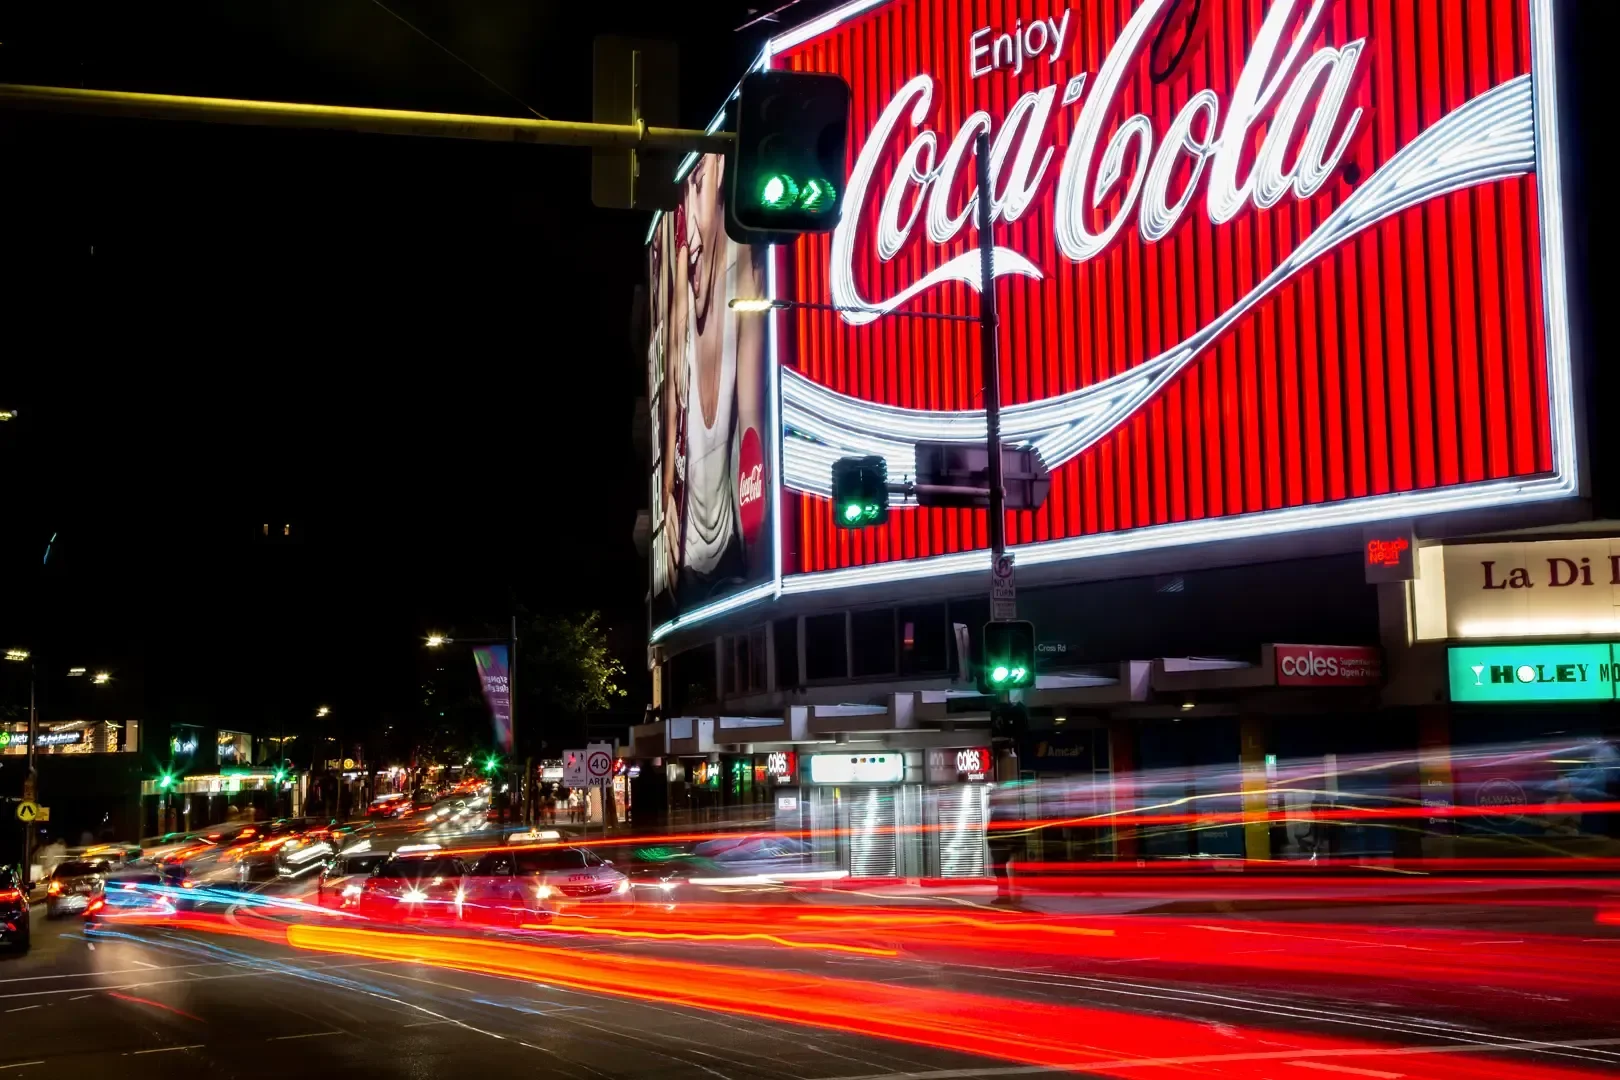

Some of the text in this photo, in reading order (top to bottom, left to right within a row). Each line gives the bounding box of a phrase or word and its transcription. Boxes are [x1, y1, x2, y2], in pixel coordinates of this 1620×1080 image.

[970, 8, 1070, 79] Enjoy
[1480, 561, 1534, 589] La
[1546, 557, 1594, 587] Di
[995, 579, 1004, 587] NO
[997, 589, 1013, 597] TURN
[1037, 644, 1056, 652] Cross
[1058, 644, 1066, 652] Rd
[1282, 651, 1338, 676] coles
[1340, 667, 1359, 678] Open
[1490, 664, 1589, 683] HOLEY
[10, 734, 28, 743] Metr
[591, 759, 608, 770] 40
[768, 752, 786, 773] coles
[957, 749, 980, 771] coles
